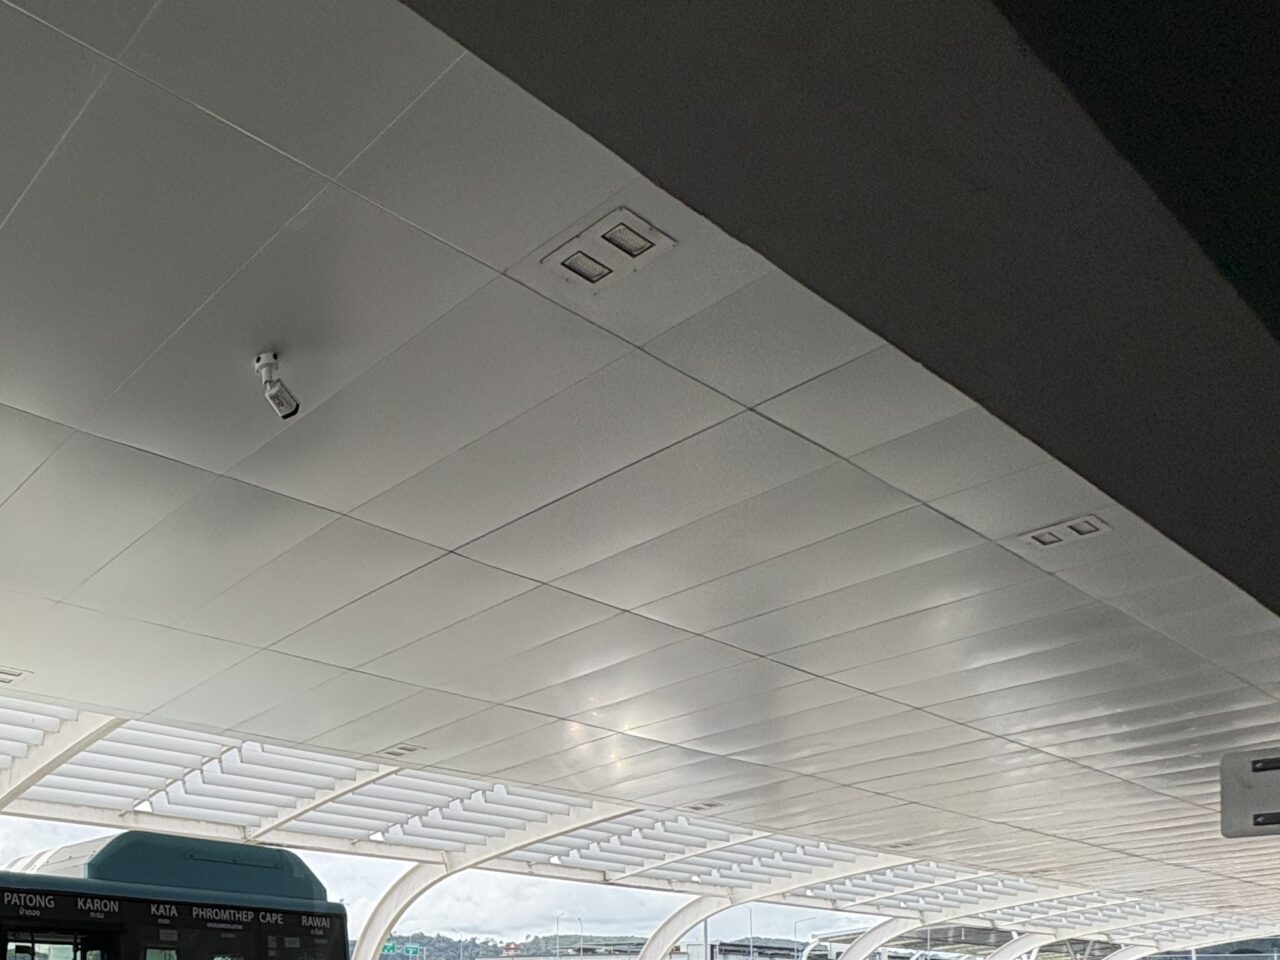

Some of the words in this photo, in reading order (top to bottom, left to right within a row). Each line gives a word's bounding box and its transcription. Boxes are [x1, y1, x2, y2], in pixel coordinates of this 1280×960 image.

[3, 891, 55, 908] PATONG
[77, 896, 119, 912] KARON
[150, 903, 178, 918] KATA
[192, 906, 255, 922] PHROMTHEP
[258, 911, 284, 925] CAPE
[301, 915, 330, 928] RAWAI
